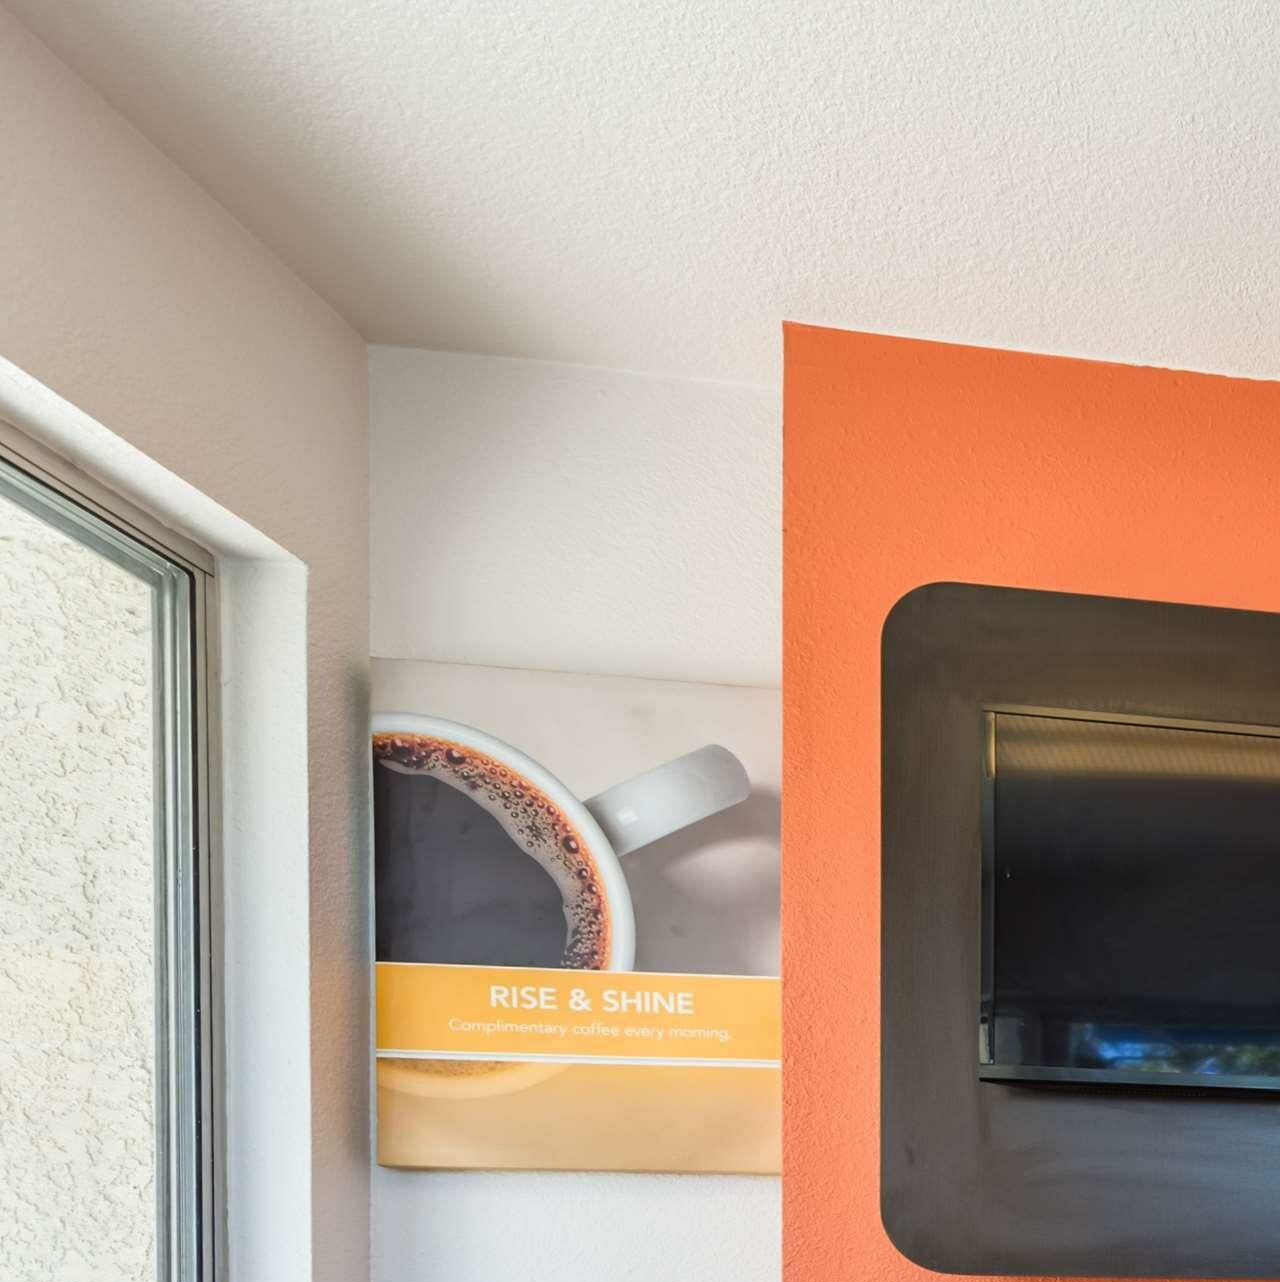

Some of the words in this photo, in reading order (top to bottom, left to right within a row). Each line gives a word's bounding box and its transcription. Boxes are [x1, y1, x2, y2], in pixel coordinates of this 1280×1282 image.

[490, 985, 557, 1010] RISE
[569, 988, 592, 1012] &
[602, 990, 695, 1015] SHINE
[449, 1017, 567, 1037] Complimentary
[573, 1022, 619, 1038] coffee
[624, 1027, 663, 1041] every
[669, 1027, 731, 1042] morning.
